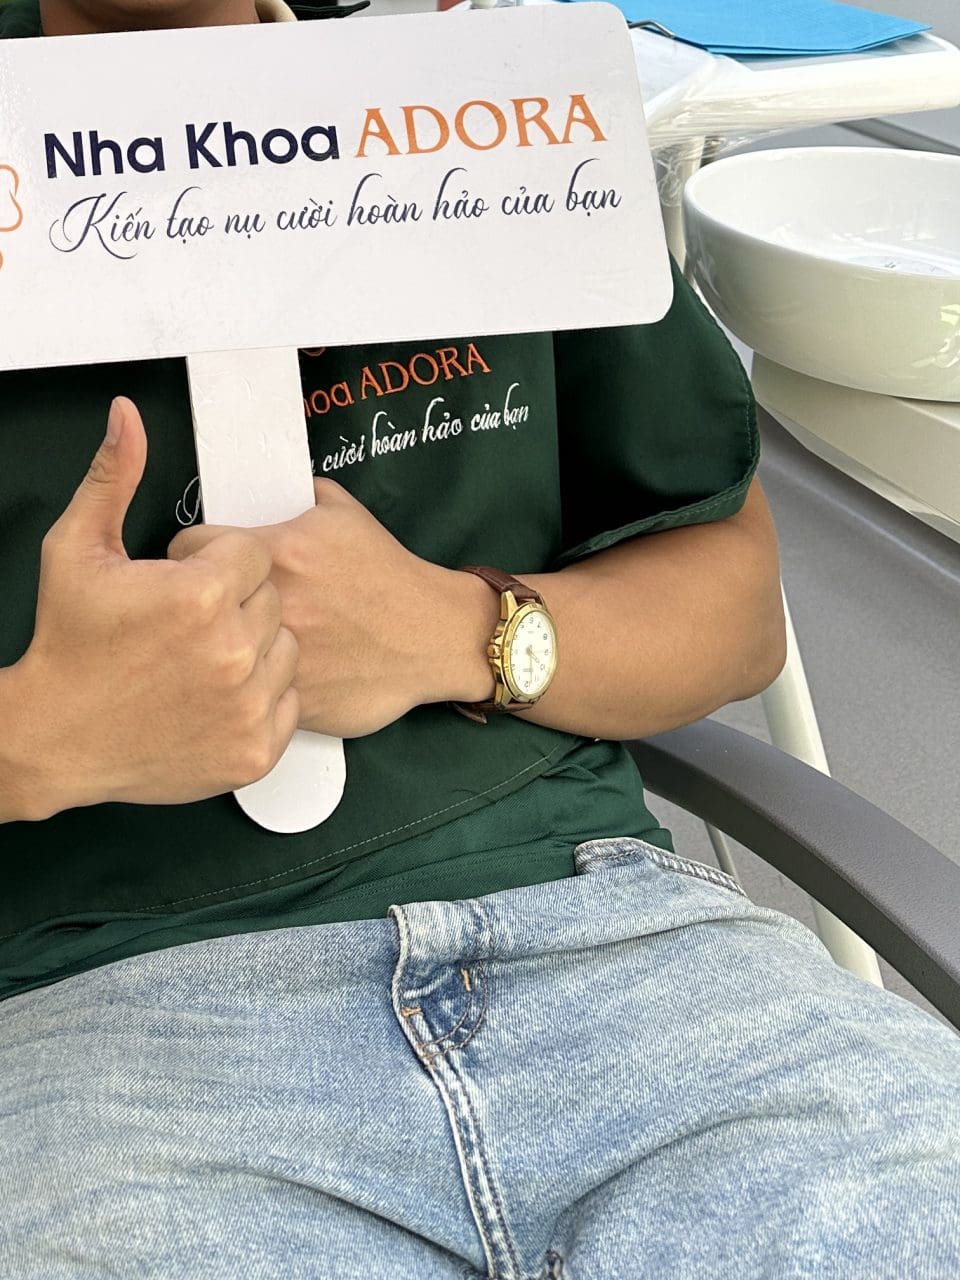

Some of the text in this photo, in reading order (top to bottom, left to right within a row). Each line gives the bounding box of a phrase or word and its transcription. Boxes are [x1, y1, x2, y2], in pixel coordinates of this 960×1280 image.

[43, 93, 608, 179] Nha Khoa ADORA
[48, 157, 622, 260] Kiến tạo nụ cười hoàn hảo của bạn
[360, 342, 491, 400] ADORA
[322, 382, 530, 473] cười hoàn hảo của bạn
